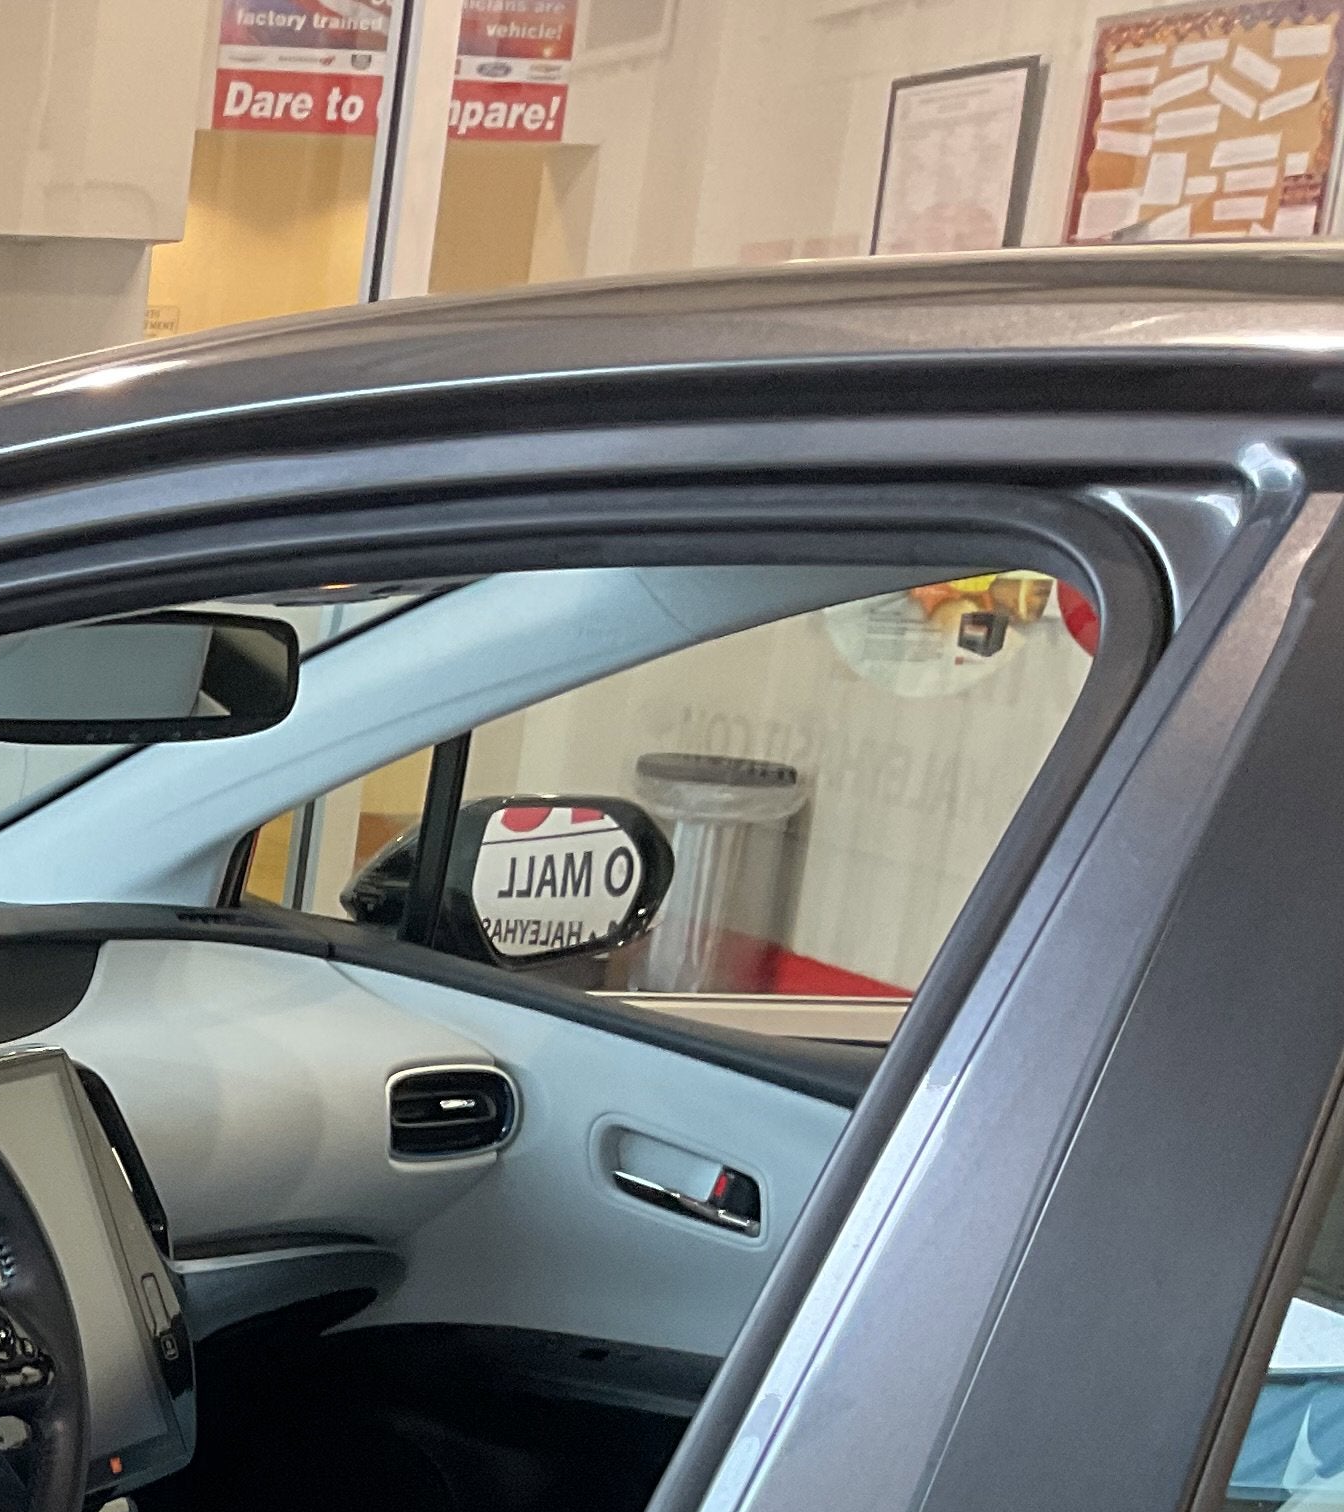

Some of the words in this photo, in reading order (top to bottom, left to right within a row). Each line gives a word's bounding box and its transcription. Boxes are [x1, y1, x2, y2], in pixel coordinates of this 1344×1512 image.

[236, 9, 306, 31] factory
[313, 13, 383, 31] trained
[487, 22, 563, 40] vehicle!
[223, 81, 313, 121] Dare
[325, 87, 364, 122] to
